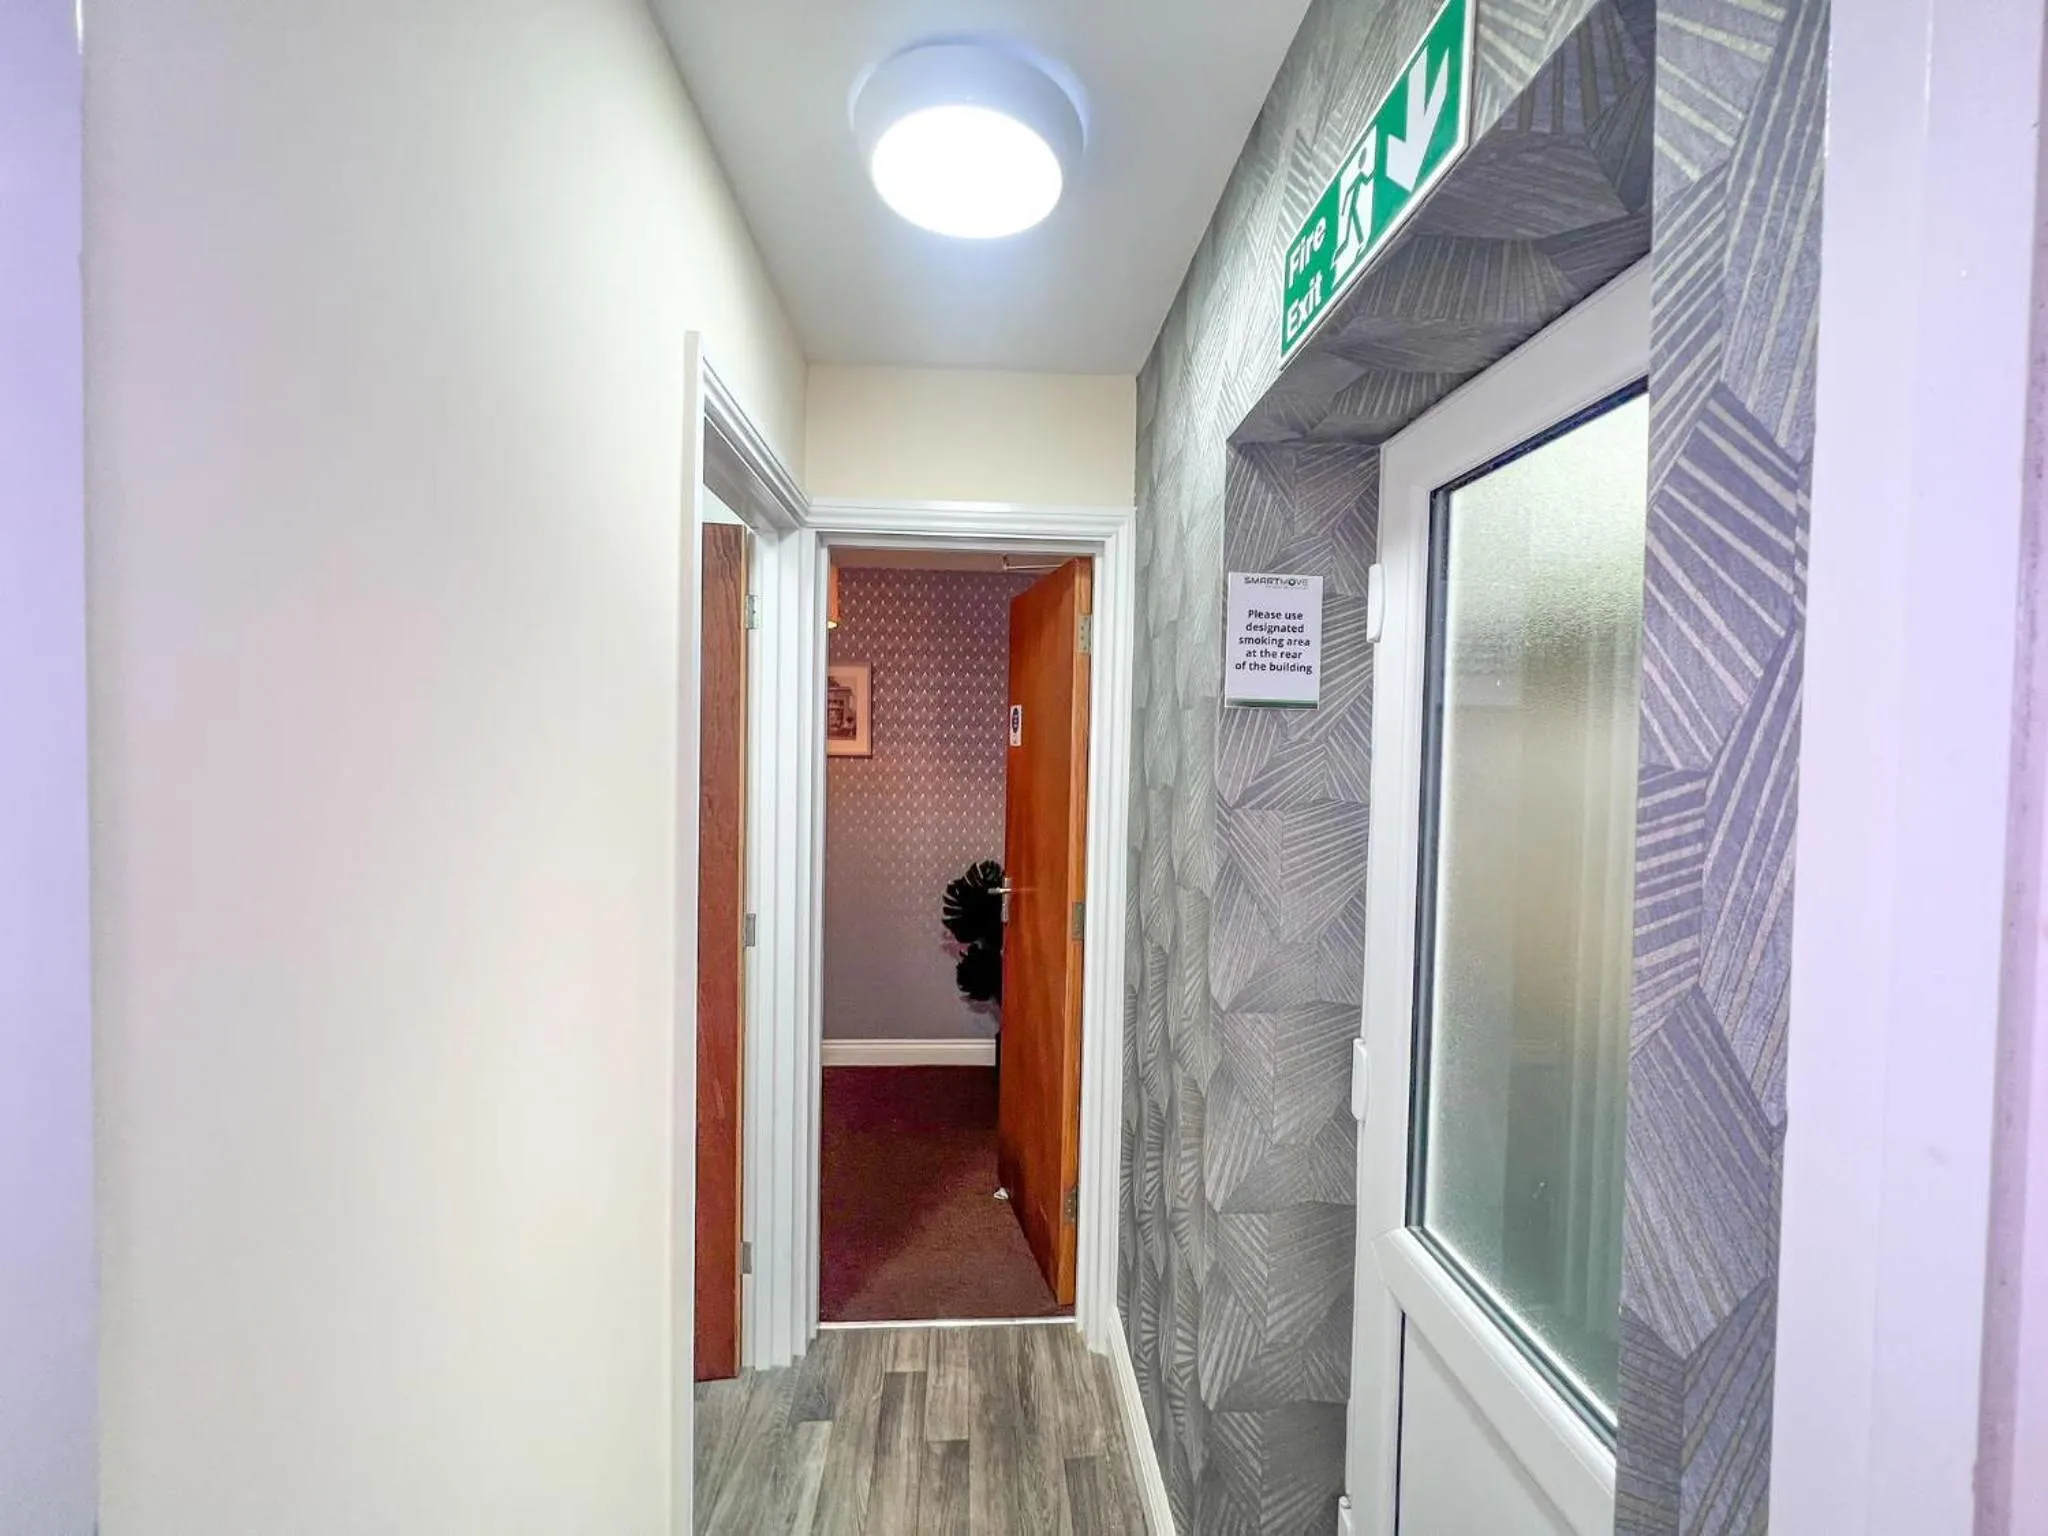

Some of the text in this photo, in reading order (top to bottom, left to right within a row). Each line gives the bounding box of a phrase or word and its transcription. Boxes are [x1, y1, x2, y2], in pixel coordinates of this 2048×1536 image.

[1288, 217, 1327, 289] Fire
[1286, 270, 1323, 342] Exit
[1248, 609, 1303, 620] Please use
[1245, 623, 1304, 634] designated
[1238, 636, 1310, 648] smoking area
[1245, 649, 1303, 659] at the rear
[1235, 661, 1313, 675] of the building
